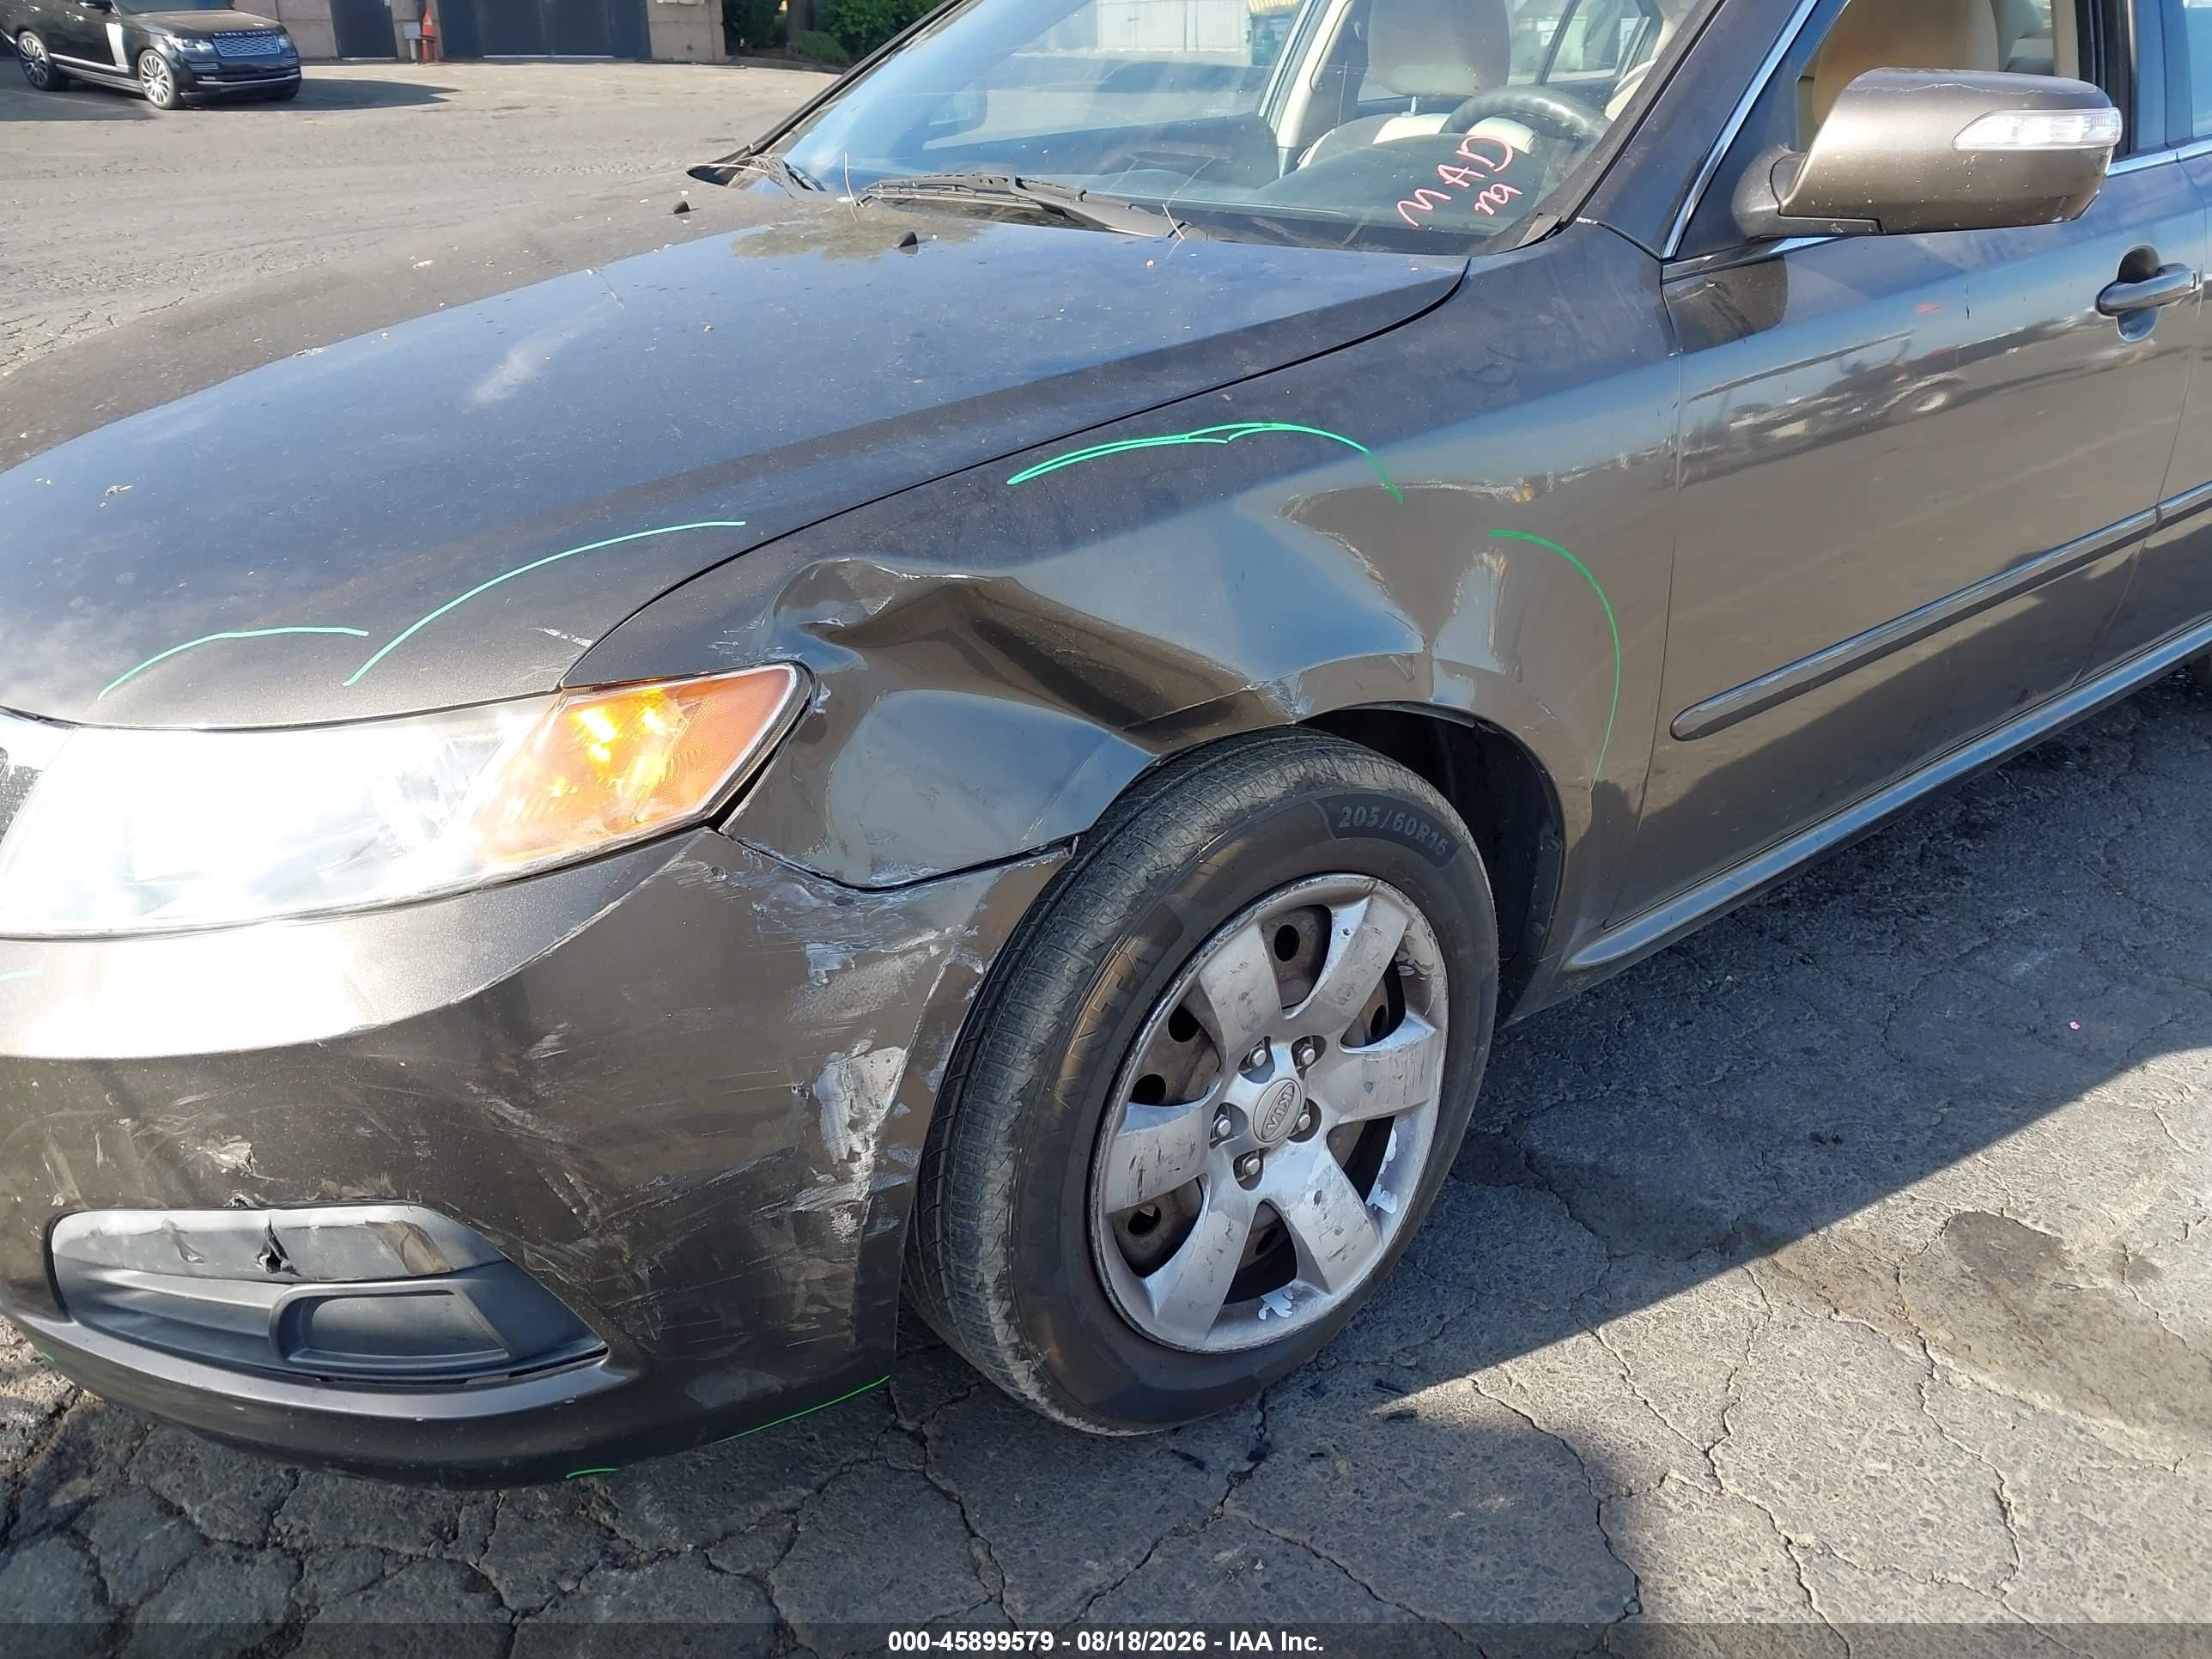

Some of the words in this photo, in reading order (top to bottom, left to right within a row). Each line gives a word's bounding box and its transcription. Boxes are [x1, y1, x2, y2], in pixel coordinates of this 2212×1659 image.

[1397, 135, 1514, 228] MAD
[1339, 805, 1449, 856] 205/60R16
[1265, 1092, 1293, 1130] KIA
